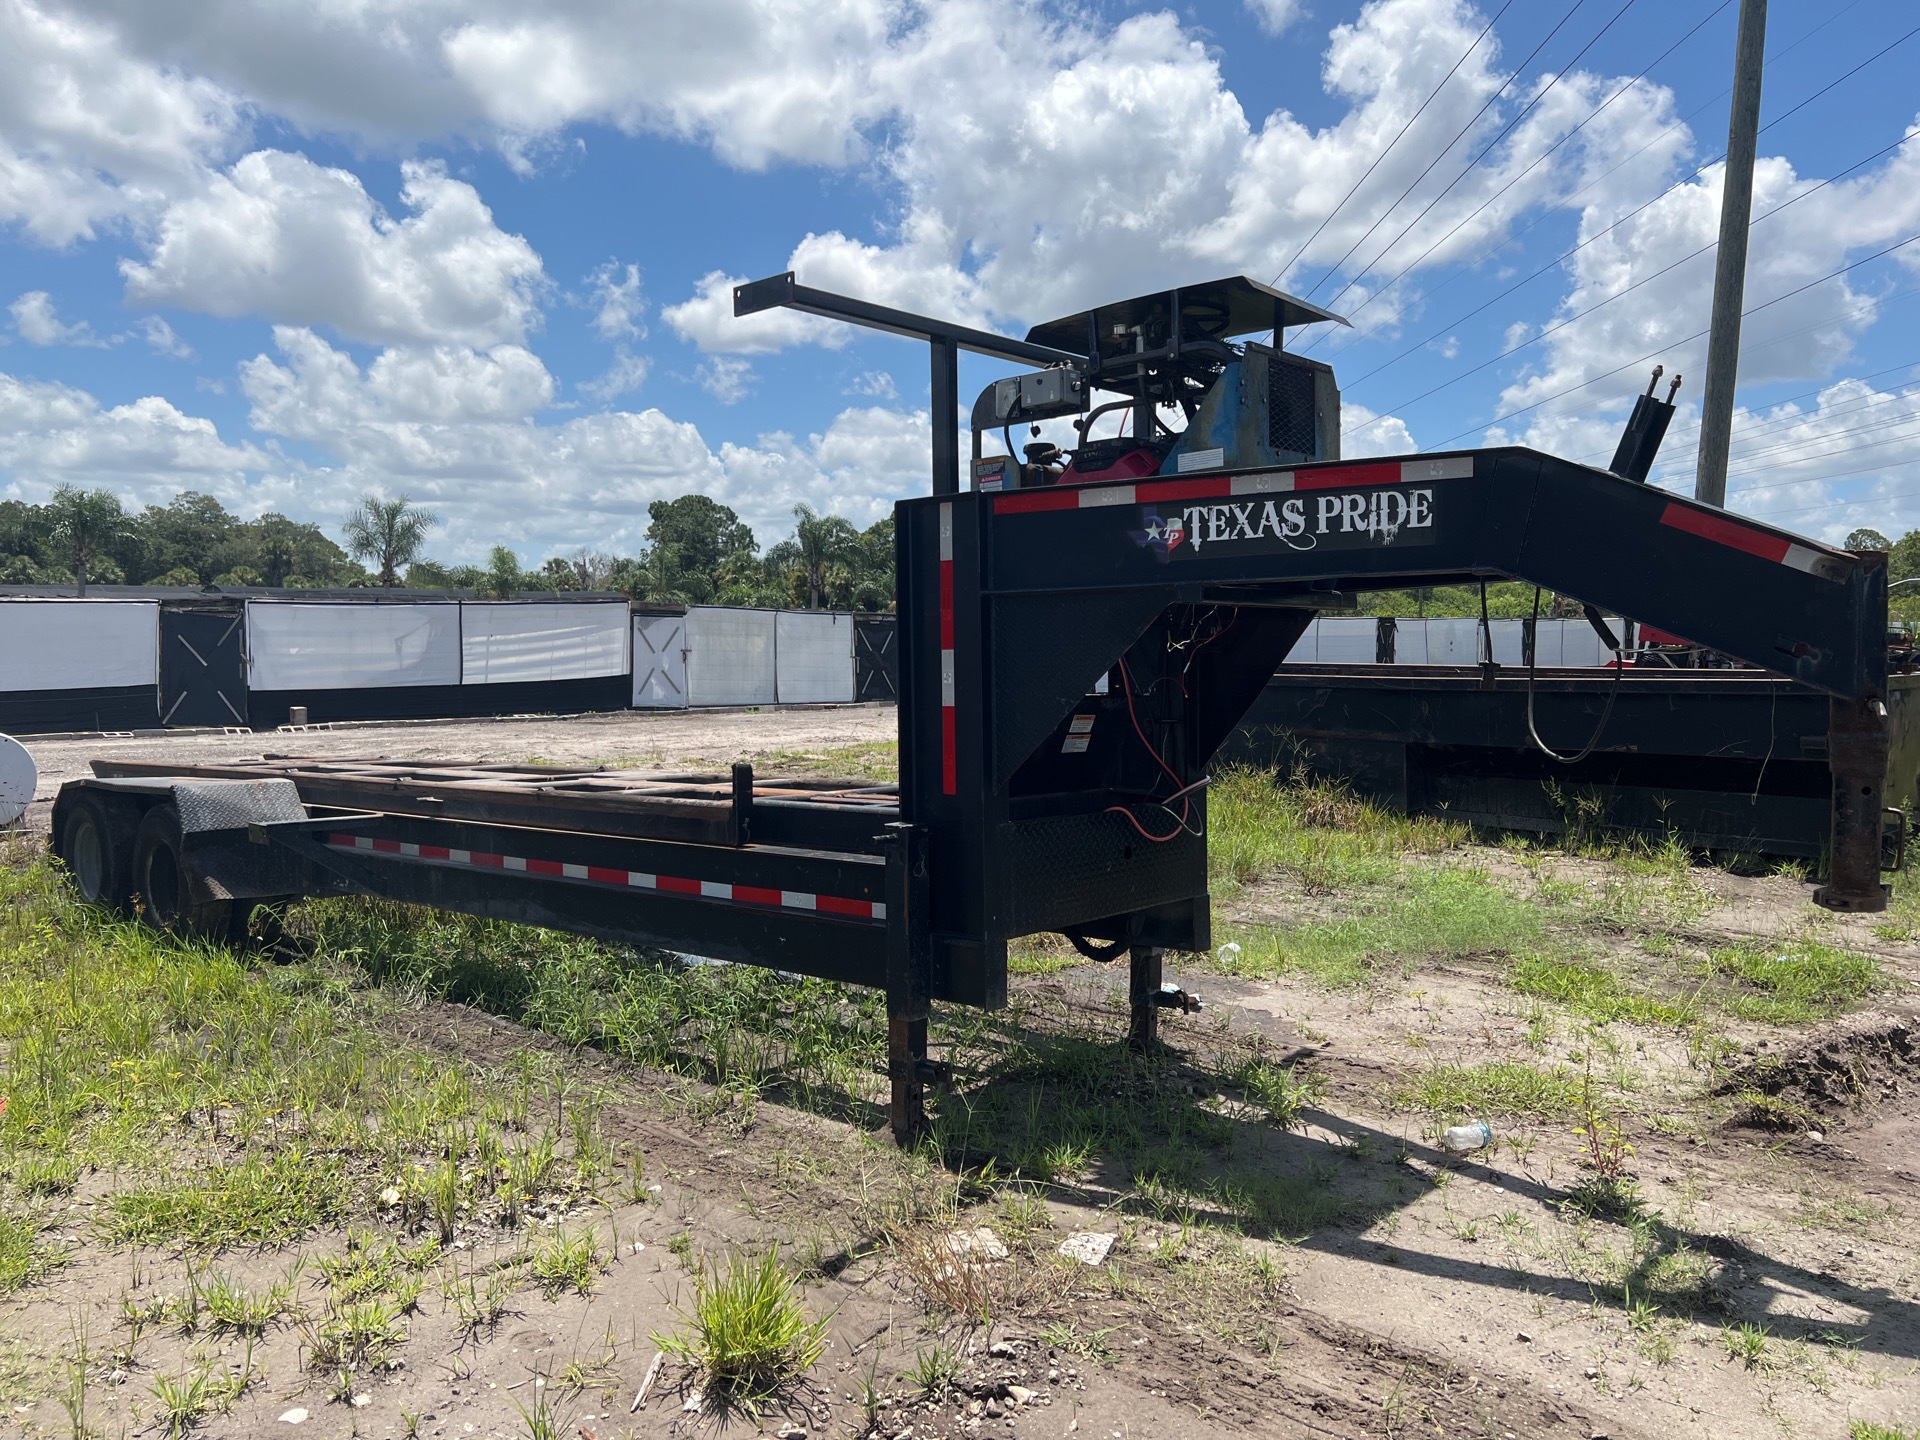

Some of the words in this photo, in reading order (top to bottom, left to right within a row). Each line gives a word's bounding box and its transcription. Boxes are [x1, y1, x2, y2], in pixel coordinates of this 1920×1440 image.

[1163, 527, 1179, 545] TP
[1183, 499, 1317, 552] TEXAS
[1316, 489, 1433, 545] PRIDE
